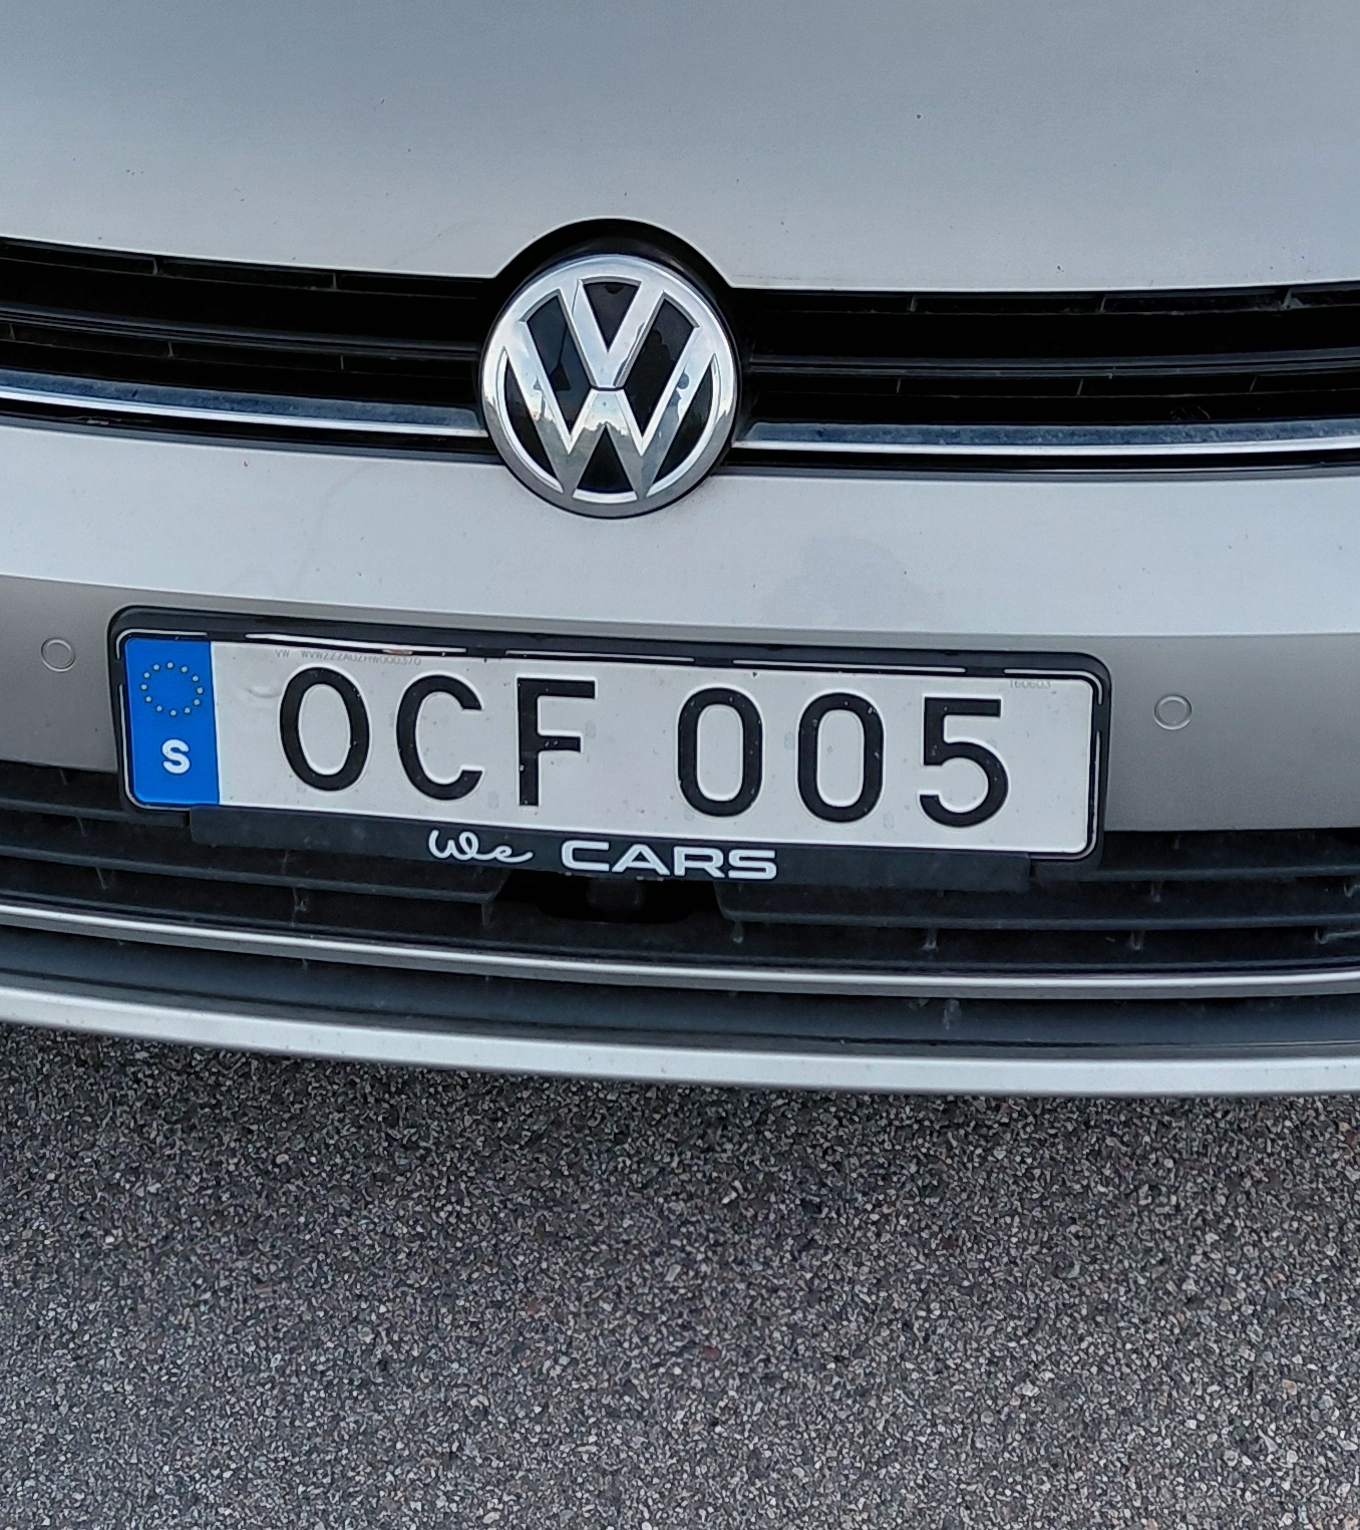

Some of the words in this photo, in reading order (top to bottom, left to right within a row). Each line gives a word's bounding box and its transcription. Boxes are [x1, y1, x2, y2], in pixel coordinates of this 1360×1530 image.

[482, 254, 736, 519] VW
[161, 738, 191, 774] S
[279, 666, 597, 807] OCF
[677, 686, 1010, 828] 005
[427, 828, 534, 864] We
[560, 839, 778, 880] CARS
